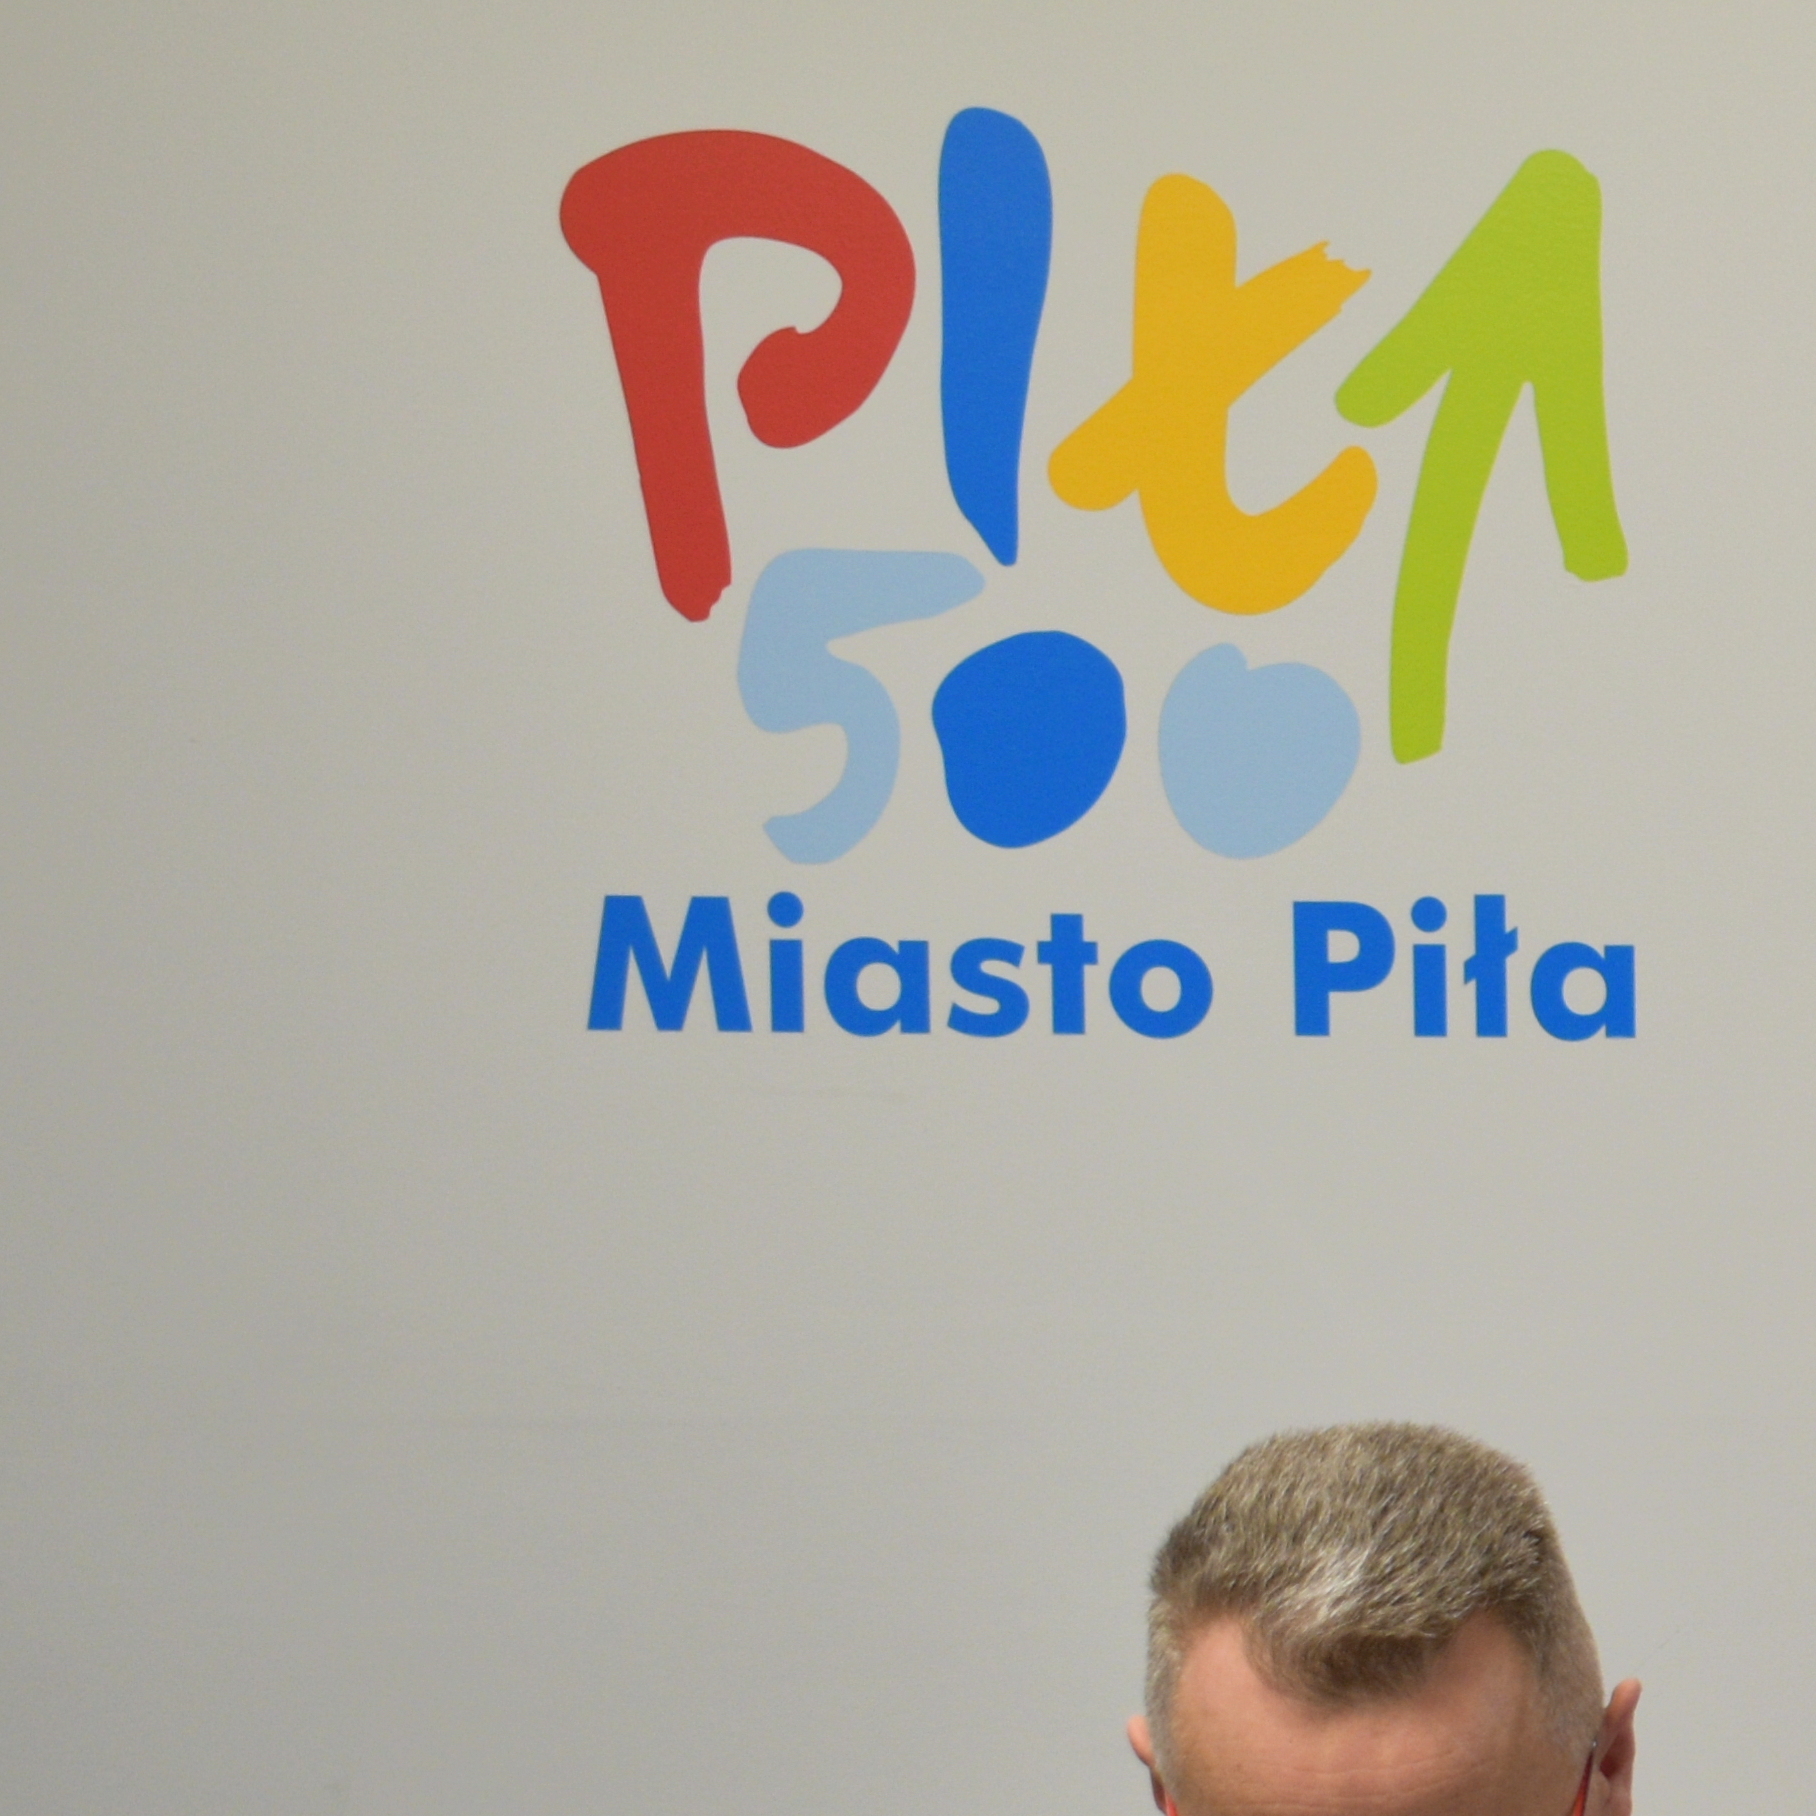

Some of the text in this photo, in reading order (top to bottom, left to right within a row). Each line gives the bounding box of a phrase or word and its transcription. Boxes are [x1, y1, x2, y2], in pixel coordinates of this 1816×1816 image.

[737, 548, 1361, 864] 500
[587, 891, 1638, 1043] Miasto Piła
